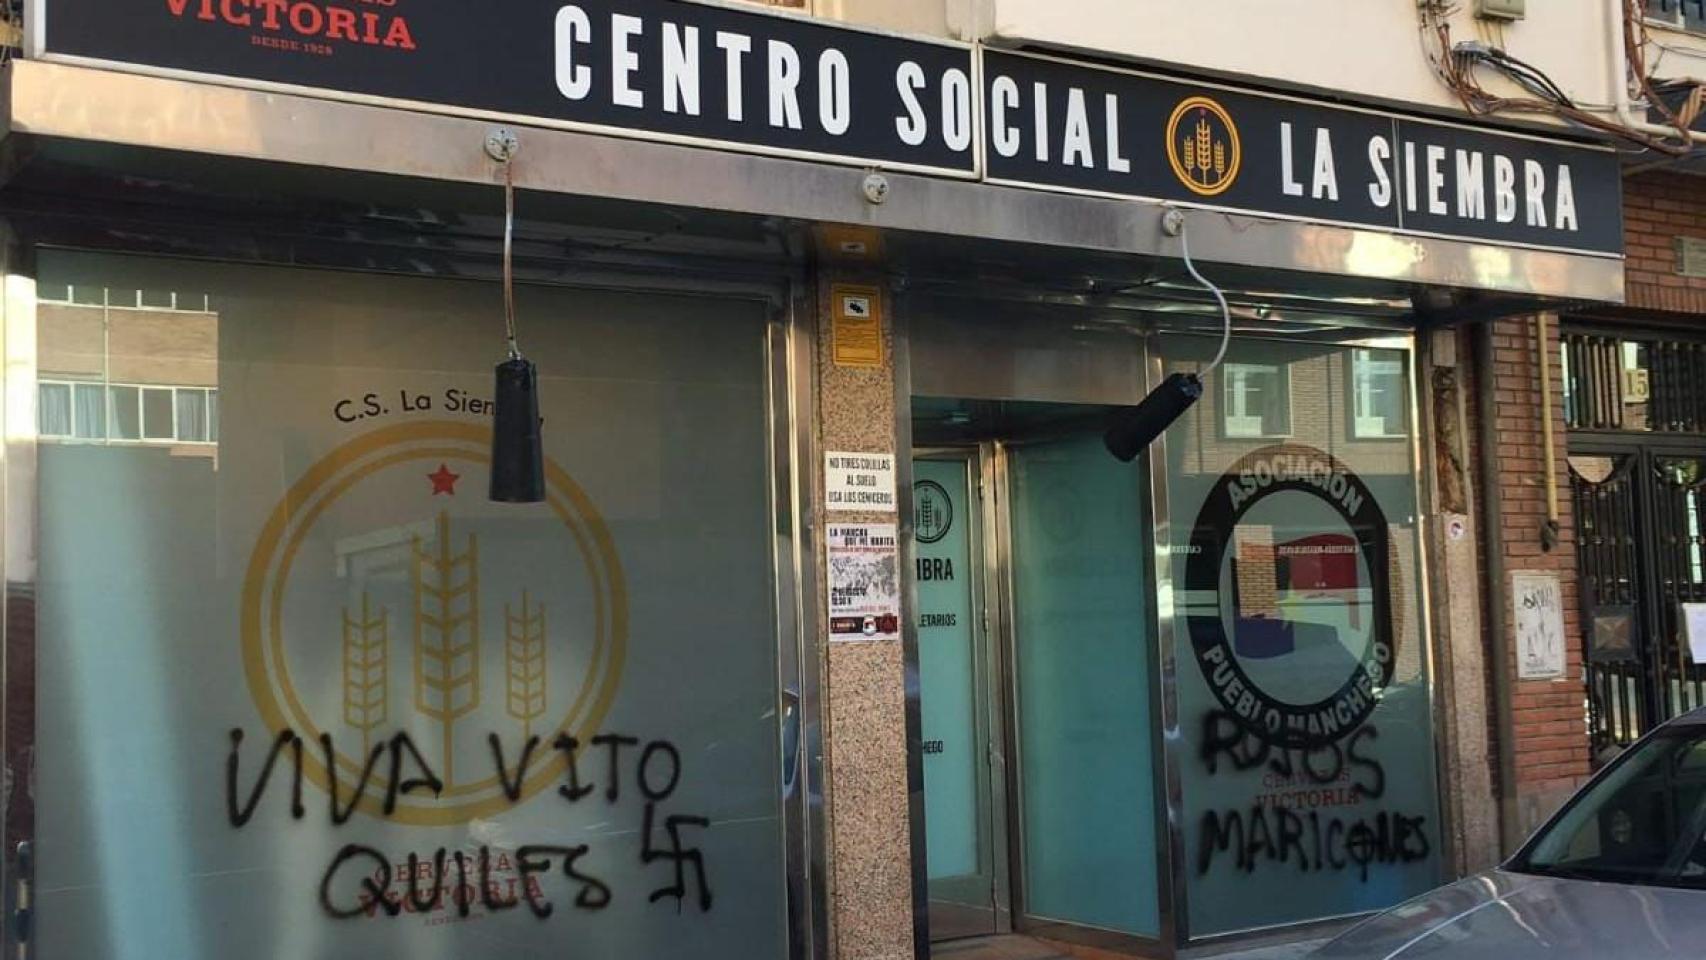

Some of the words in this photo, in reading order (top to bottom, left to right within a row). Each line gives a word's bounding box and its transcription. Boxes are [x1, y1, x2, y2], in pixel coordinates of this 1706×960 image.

[165, 0, 417, 50] VICTORIA
[252, 35, 300, 51] DESDE
[554, 5, 851, 136] CENTRO
[895, 60, 1131, 173] SOCIAL
[1280, 121, 1338, 201] LA
[1368, 135, 1579, 231] SIEMBRA
[1627, 371, 1647, 397] 15
[333, 390, 389, 423] C.S.
[400, 389, 432, 412] La
[829, 458, 839, 468] NO
[840, 458, 860, 469] TIRES
[861, 458, 891, 471] COLILLAS
[846, 474, 854, 485] AL
[856, 475, 877, 486] SUELO
[1227, 454, 1364, 516] ASOCIACIÓN
[829, 528, 838, 537] LA
[840, 528, 868, 537] MANCHA
[488, 731, 681, 802] VITO
[1197, 804, 1431, 883] MARICONES
[319, 843, 612, 920] QUILES
